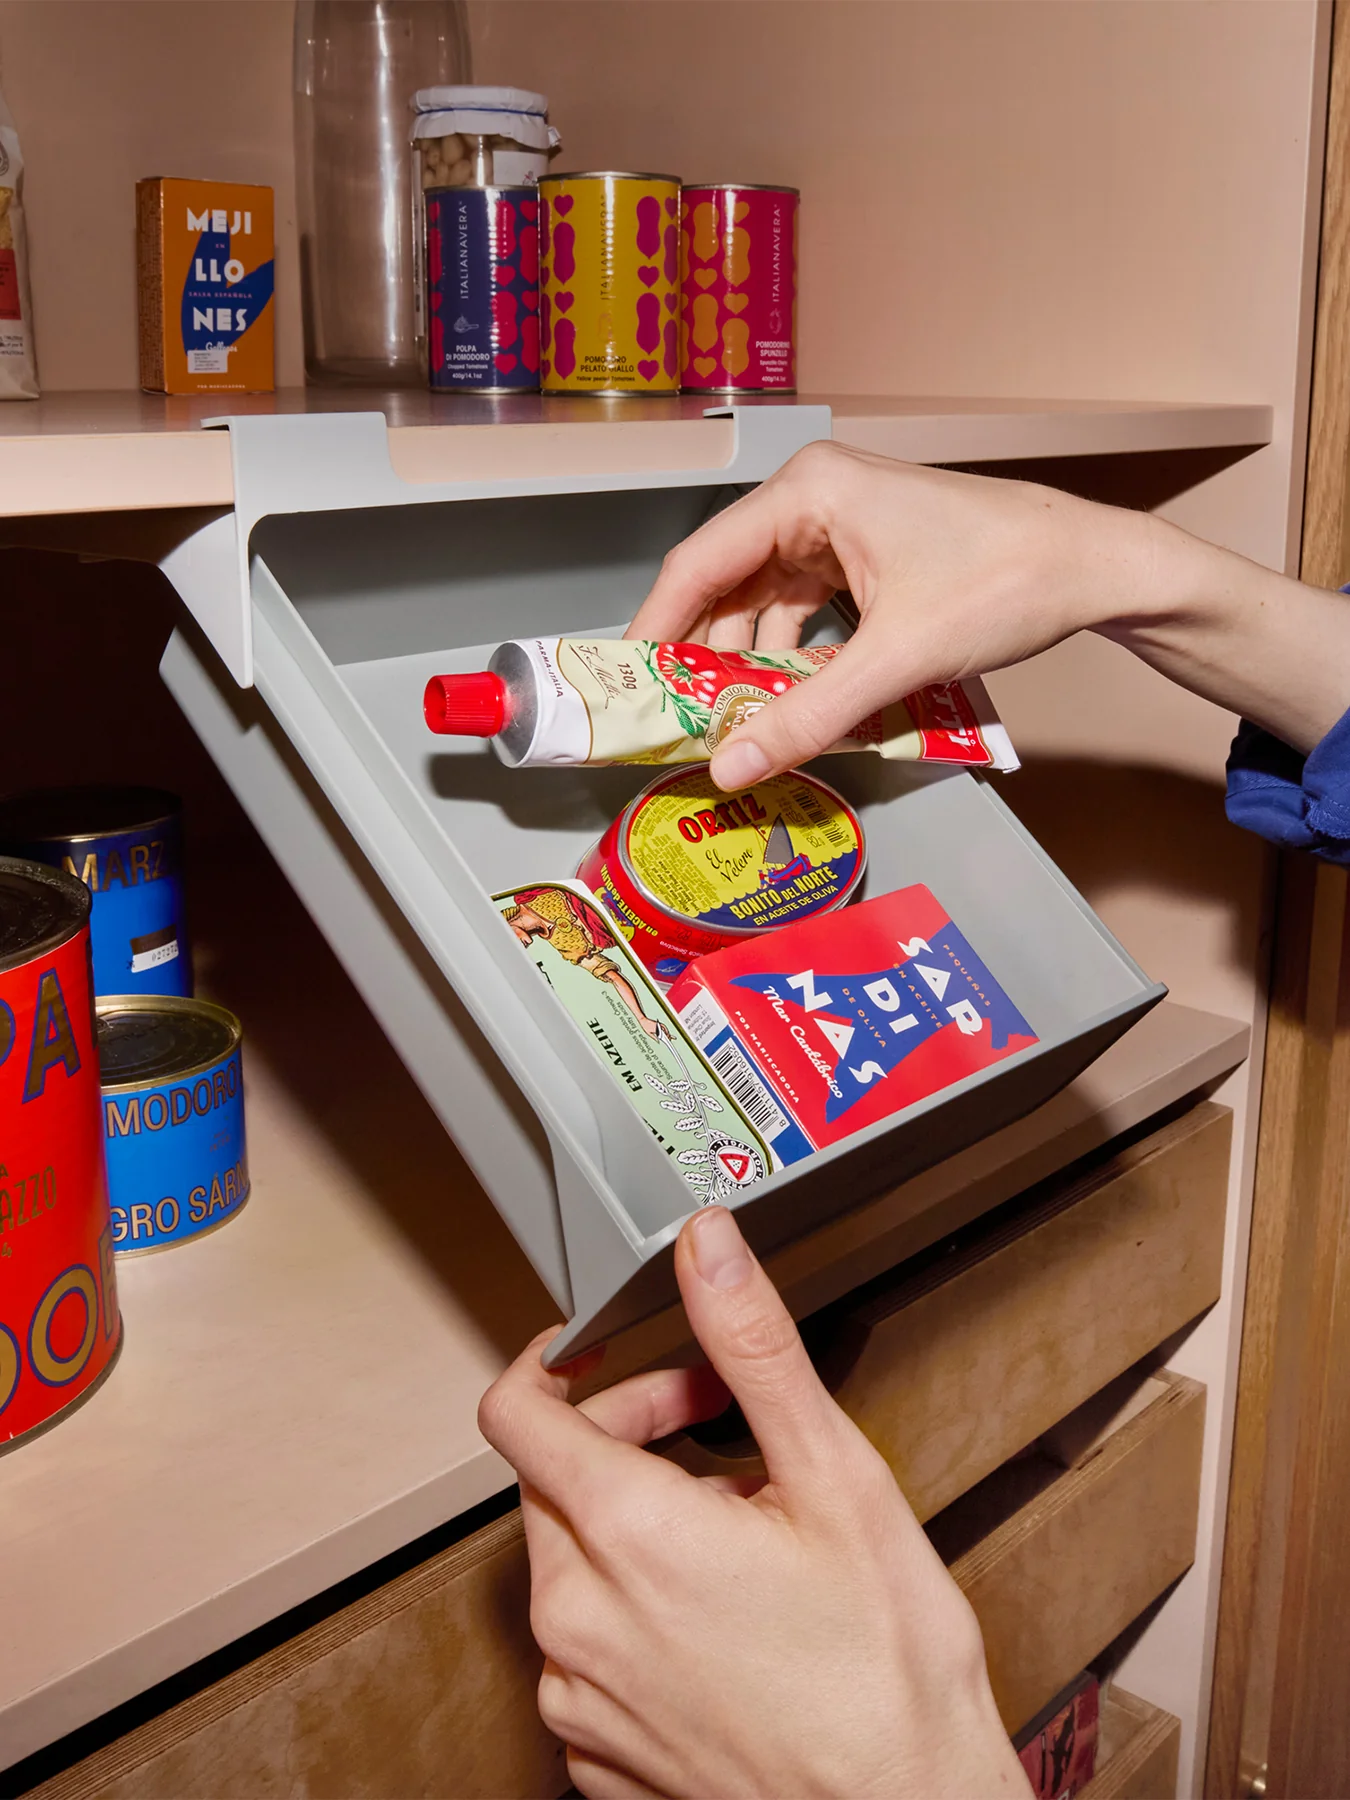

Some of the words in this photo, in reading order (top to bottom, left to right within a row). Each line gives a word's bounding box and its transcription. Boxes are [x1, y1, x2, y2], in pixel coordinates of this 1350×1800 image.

[187, 207, 252, 235] MEJI
[459, 204, 469, 299] ITALIANAVERA
[773, 208, 781, 302] ITALIANAVERA
[195, 258, 245, 283] LLO
[193, 306, 248, 332] NES
[453, 353, 490, 361] POMODORO
[455, 344, 477, 353] POLPA
[580, 364, 607, 373] PELATO
[536, 640, 564, 697] PARMA-ITALIA
[617, 662, 637, 690] 130g
[713, 685, 749, 715] TOMATOES
[752, 688, 776, 702] FRO
[677, 793, 768, 843] ORTIZ
[729, 888, 783, 920] BONITO
[781, 886, 799, 900] DEL
[795, 865, 839, 898] NORTE
[753, 914, 768, 926] EN
[768, 900, 799, 921] ACEITE
[798, 895, 813, 907] DE
[812, 884, 838, 901] OLIVA
[617, 899, 647, 929] ACEITE
[645, 926, 658, 937] en
[943, 944, 991, 1007] PEQUEÑAS
[863, 977, 920, 1034] DI
[893, 962, 907, 980] EN
[907, 984, 944, 1029] ACEITE
[841, 987, 855, 1004] DE
[857, 1009, 887, 1048] OLIVA
[586, 1017, 626, 1067] AZEITE
[639, 1033, 654, 1054] Omega
[735, 1011, 750, 1032] POR
[750, 1033, 800, 1103] MARISCADORA
[762, 985, 790, 1024] Mar
[789, 1025, 844, 1100] Cantábrico
[650, 1061, 664, 1078] Fonte
[657, 1061, 673, 1080] Source
[729, 1045, 754, 1081] 916052
[621, 1070, 643, 1092] EM
[717, 1140, 763, 1173] PORTUGAL
[110, 1196, 180, 1243] GRO
